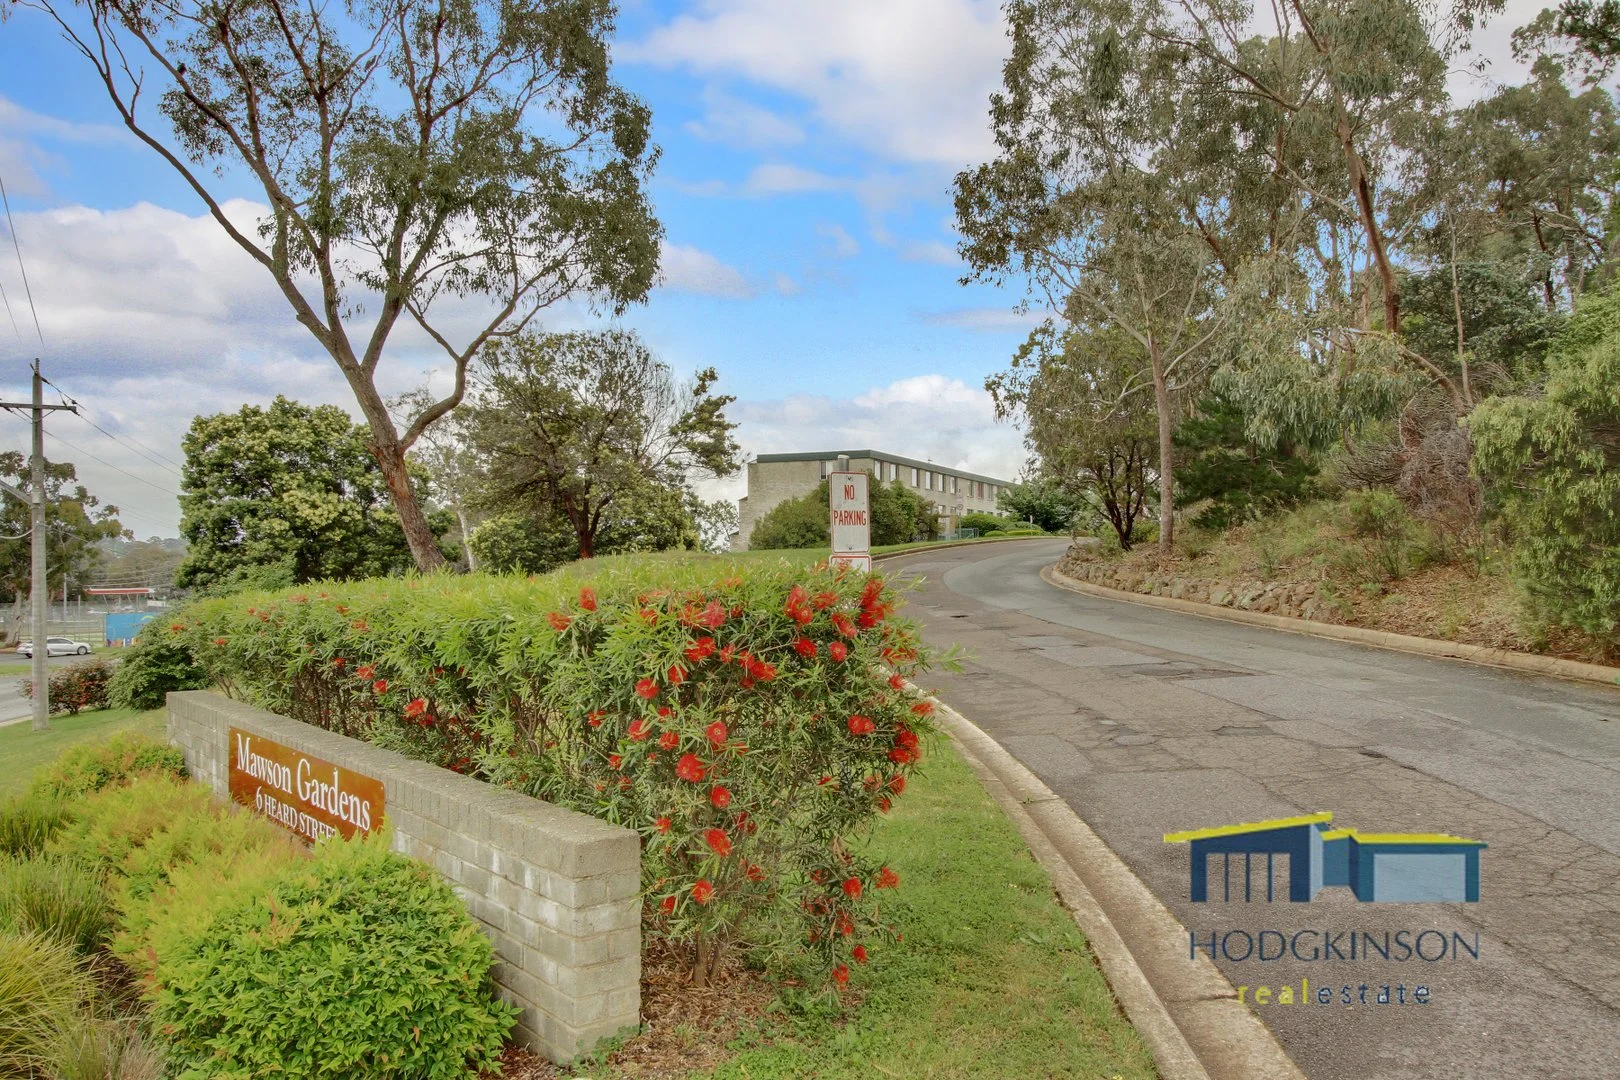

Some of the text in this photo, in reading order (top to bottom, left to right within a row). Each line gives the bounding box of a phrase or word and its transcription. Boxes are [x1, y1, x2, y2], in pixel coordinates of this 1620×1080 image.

[844, 484, 855, 500] NO
[833, 510, 867, 526] PARKING
[236, 733, 371, 831] Mawson Gardens
[255, 786, 263, 810] 6
[264, 793, 298, 830] HEARD
